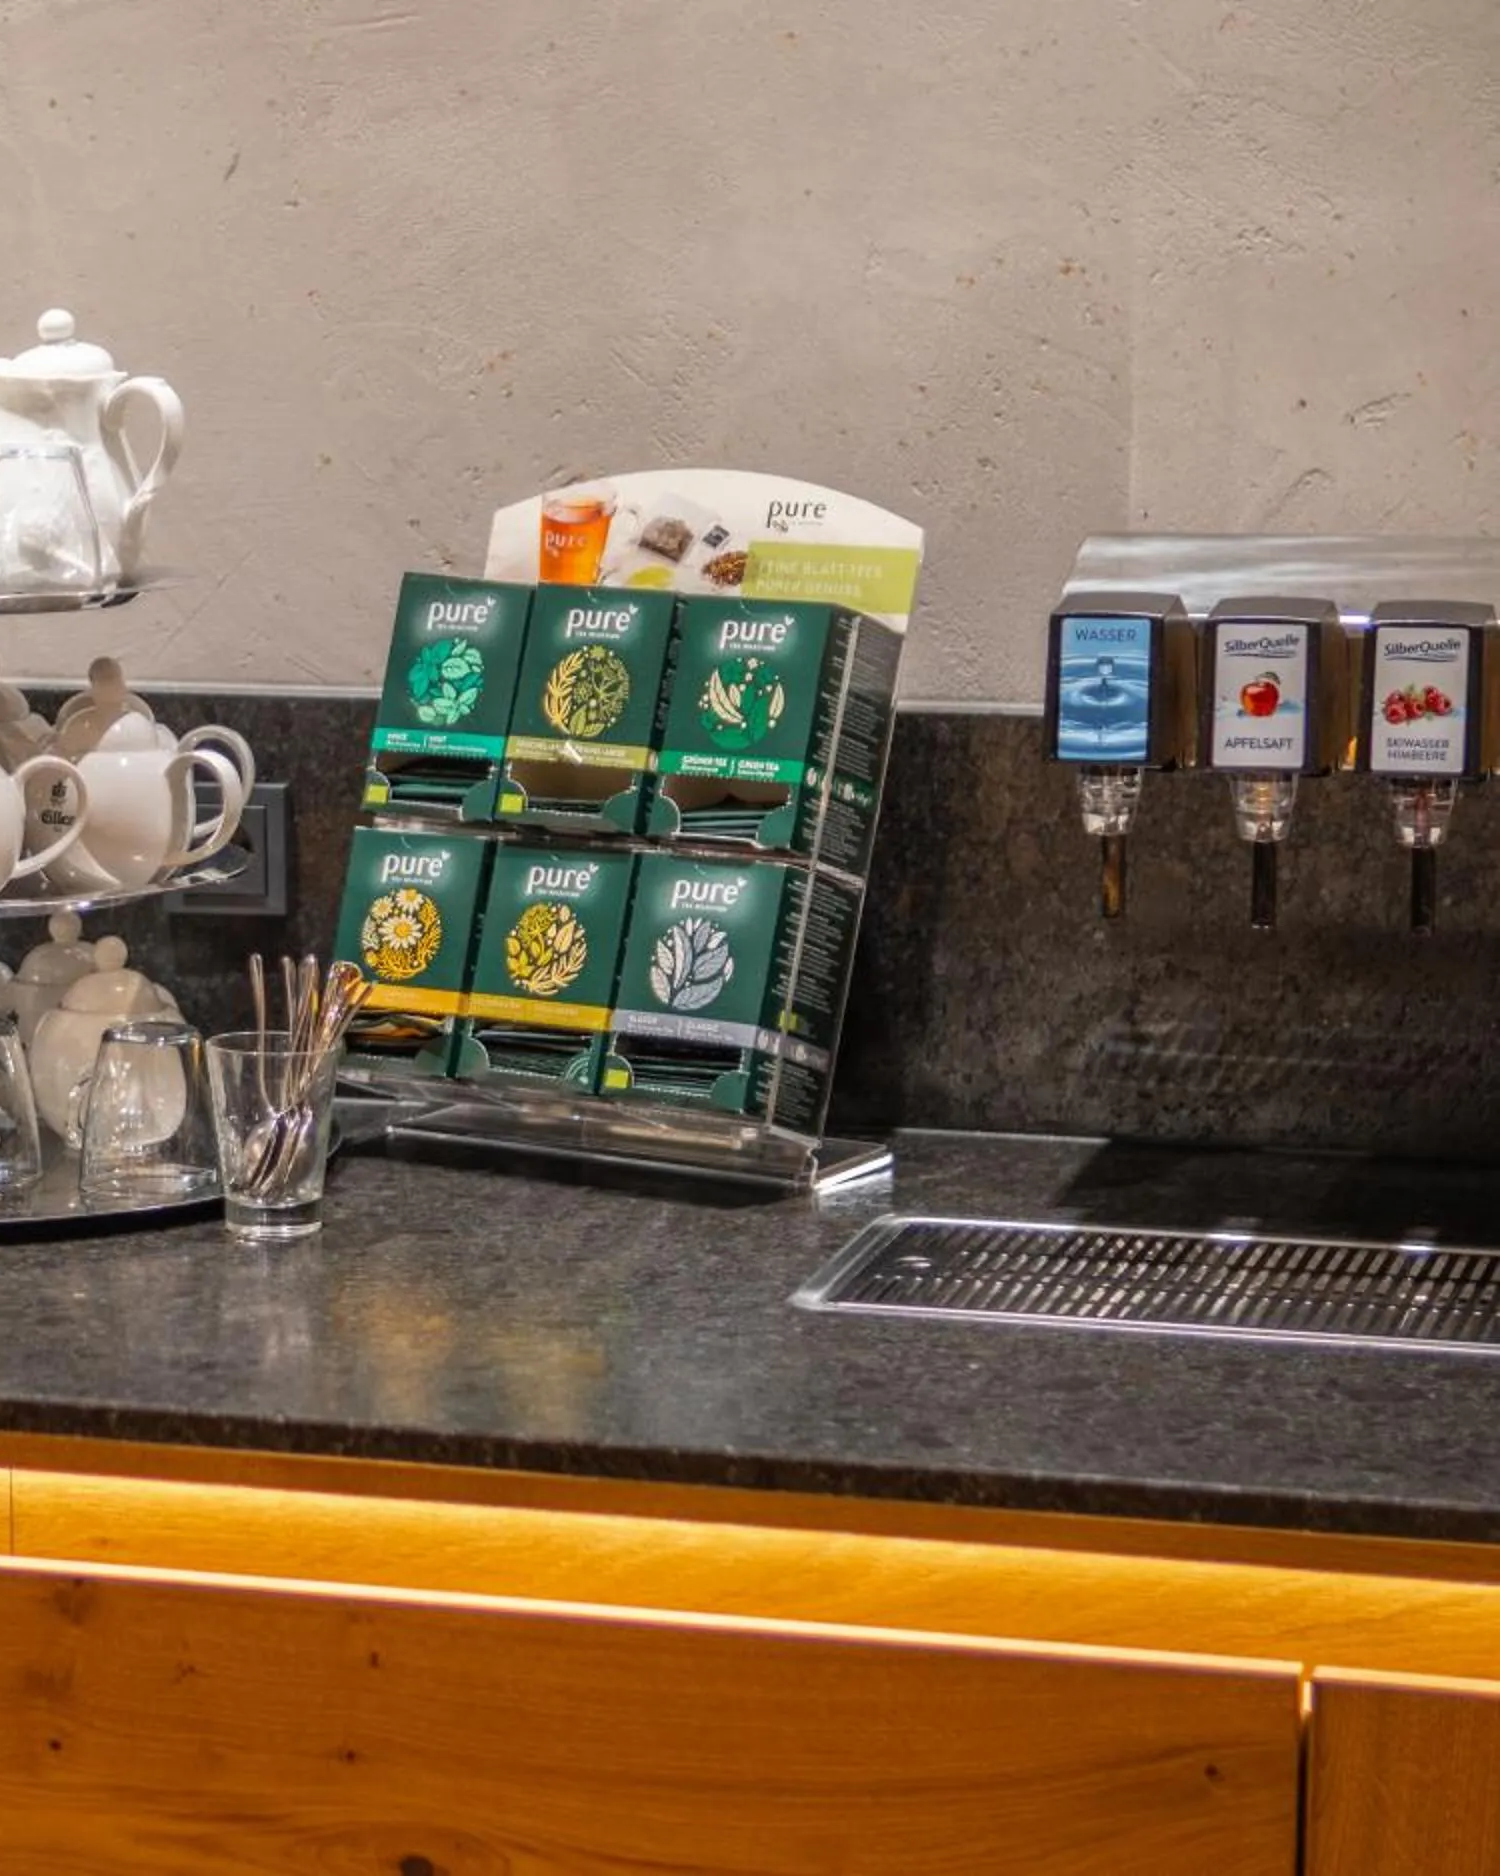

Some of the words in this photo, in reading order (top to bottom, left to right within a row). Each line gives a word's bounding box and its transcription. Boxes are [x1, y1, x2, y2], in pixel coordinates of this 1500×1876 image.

[765, 500, 828, 529] pure
[426, 601, 489, 631] pure
[564, 608, 631, 639] pure
[718, 620, 788, 650] pure
[1075, 627, 1137, 642] WASSER
[1224, 634, 1301, 653] SilberQuelle
[1383, 638, 1461, 657] SilberQuelle
[1224, 736, 1294, 750] APFELSAFT
[380, 853, 443, 884] pure
[526, 865, 591, 897] pure
[670, 879, 739, 910] pure
